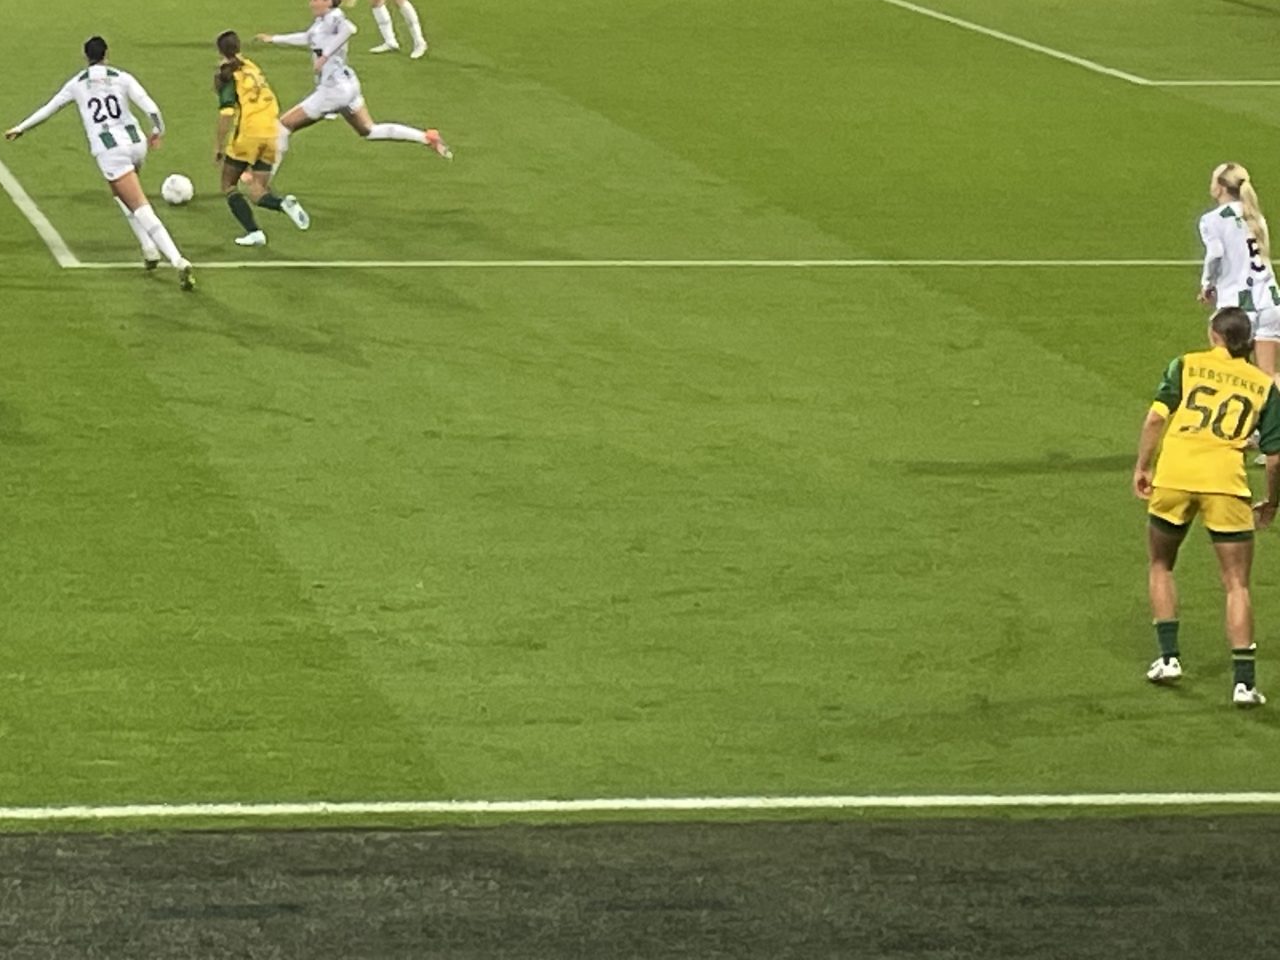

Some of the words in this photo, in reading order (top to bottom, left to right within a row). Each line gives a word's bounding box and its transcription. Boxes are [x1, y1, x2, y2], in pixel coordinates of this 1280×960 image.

[87, 94, 122, 124] 20
[1246, 238, 1266, 272] 5
[1179, 383, 1254, 441] 50
